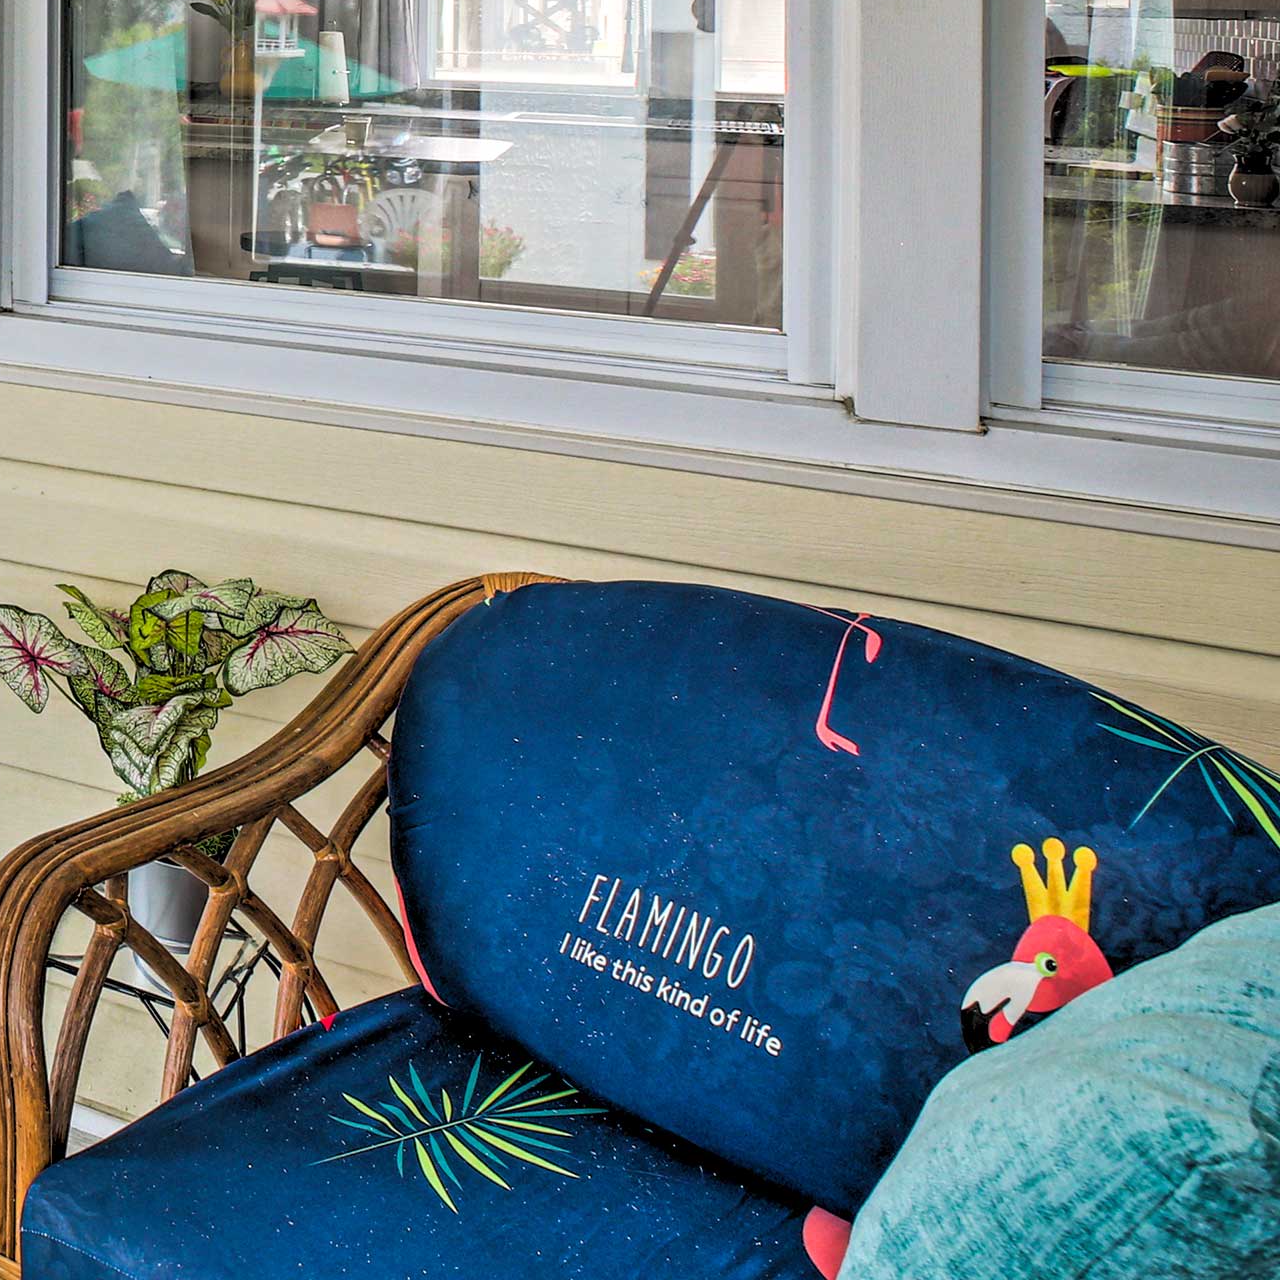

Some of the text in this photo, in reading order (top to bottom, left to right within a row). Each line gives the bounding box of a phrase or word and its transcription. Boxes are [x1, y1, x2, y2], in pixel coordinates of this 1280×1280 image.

[578, 874, 755, 989] FLAMINGO
[559, 932, 783, 1056] I like this kind of life
